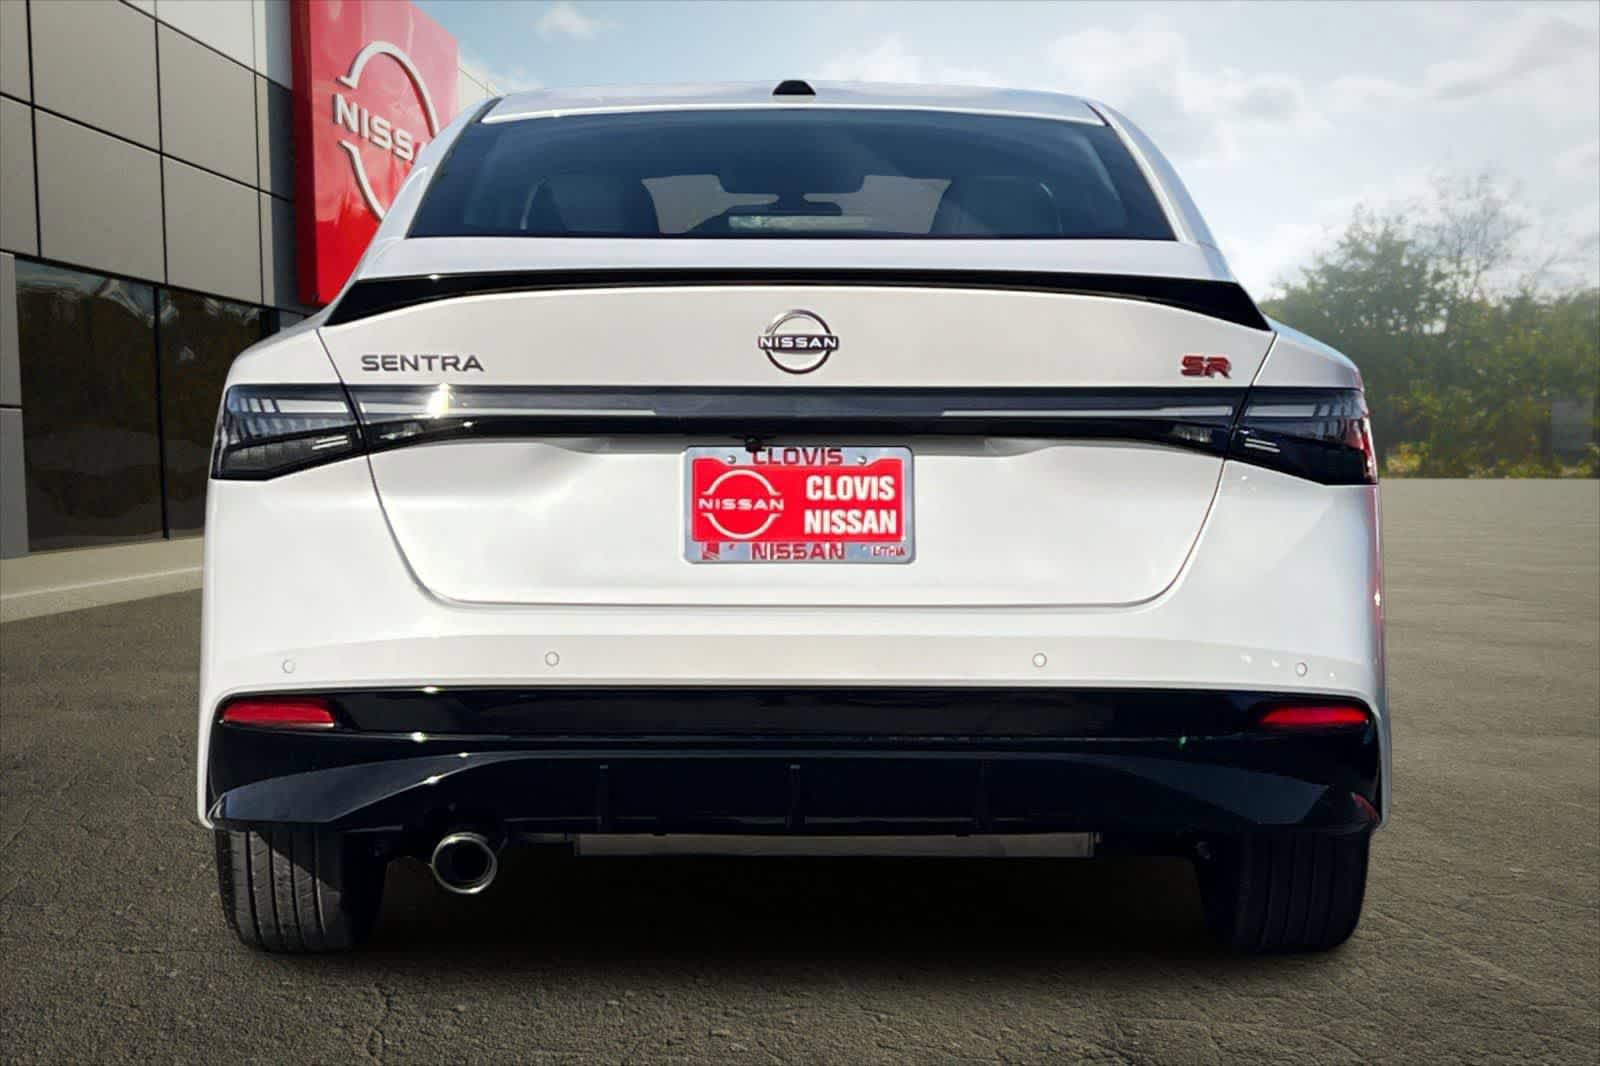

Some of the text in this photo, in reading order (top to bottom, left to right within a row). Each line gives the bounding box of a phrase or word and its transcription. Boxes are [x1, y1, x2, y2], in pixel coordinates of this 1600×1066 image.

[333, 92, 427, 164] NISS
[760, 336, 836, 348] NISSAN
[361, 354, 485, 372] SENTRA
[1181, 355, 1232, 379] SR
[752, 448, 843, 465] CLOVIS
[806, 476, 895, 500] CLOVIS
[699, 499, 784, 510] NISSAN
[804, 509, 896, 534] NISSAN
[752, 542, 845, 560] NISSAN
